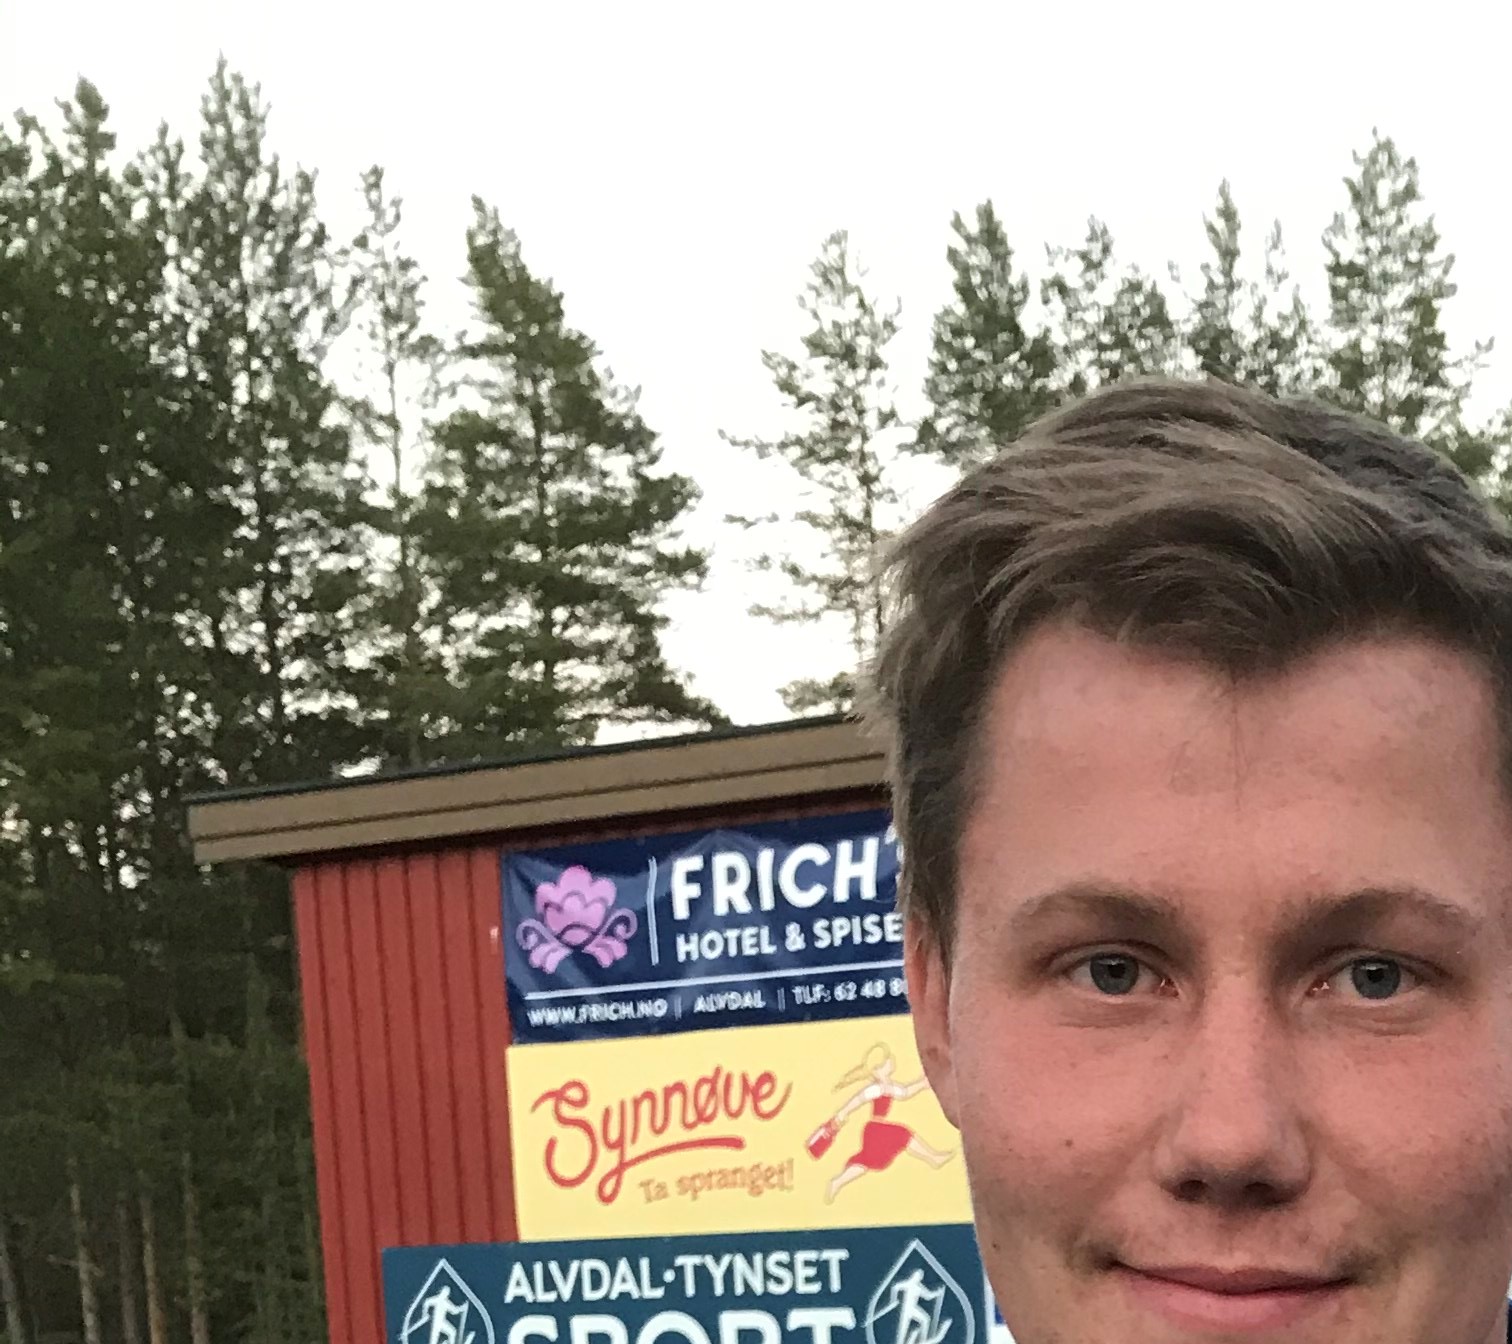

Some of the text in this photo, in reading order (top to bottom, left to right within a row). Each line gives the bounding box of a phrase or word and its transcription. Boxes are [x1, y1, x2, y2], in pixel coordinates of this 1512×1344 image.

[670, 826, 903, 920] FRICH'
[677, 926, 776, 963] HOTEL
[785, 922, 805, 952] &
[693, 989, 767, 1014] ALVDAL
[834, 980, 858, 1001] 62
[860, 978, 886, 998] 48
[531, 1065, 793, 1205] Synnøve
[638, 1157, 794, 1204] Ta spranget!
